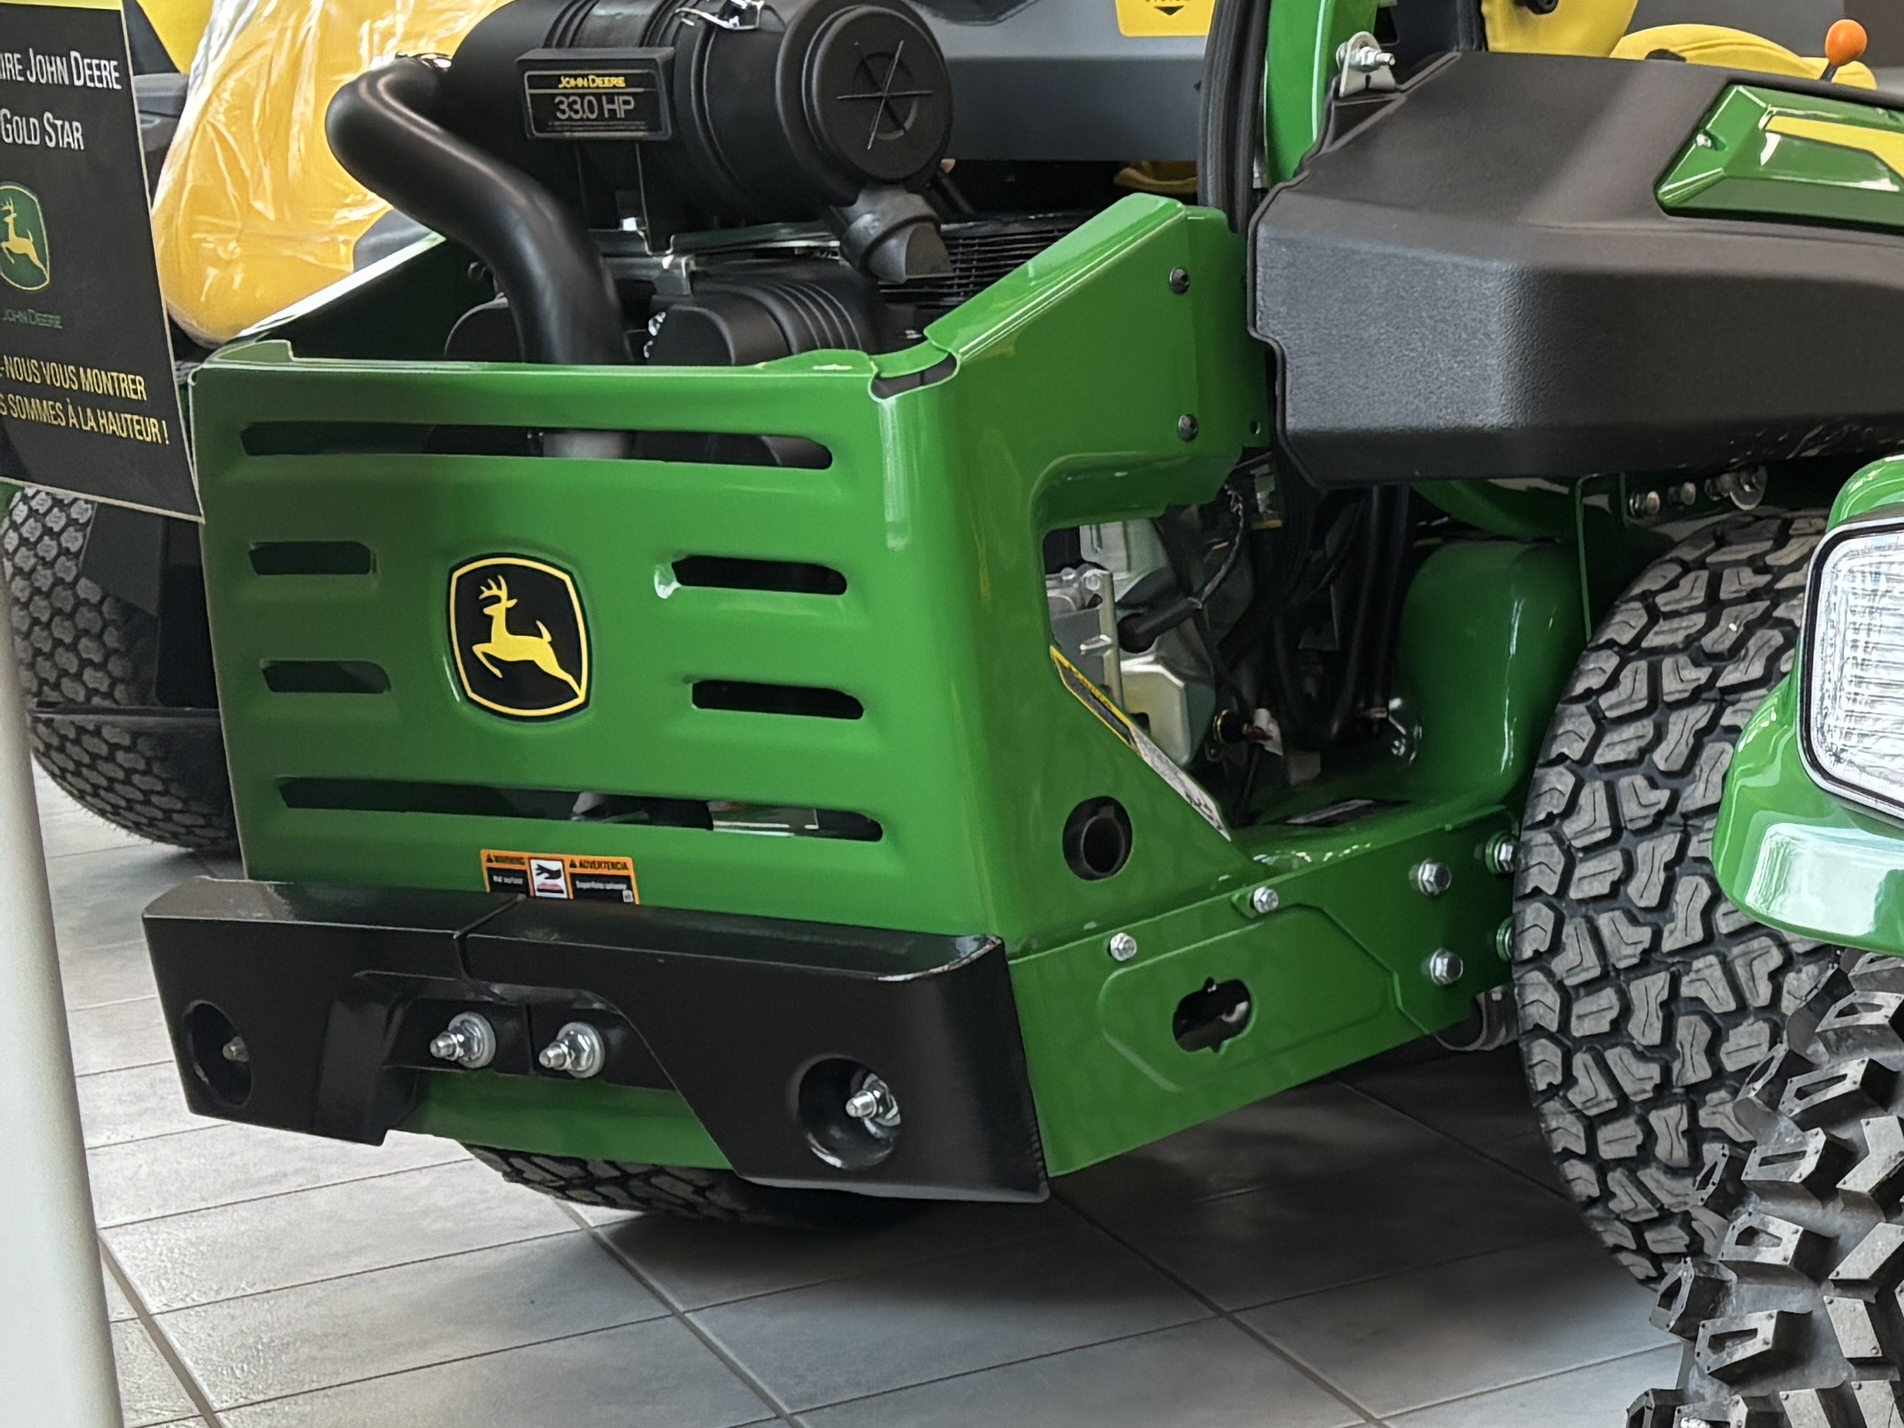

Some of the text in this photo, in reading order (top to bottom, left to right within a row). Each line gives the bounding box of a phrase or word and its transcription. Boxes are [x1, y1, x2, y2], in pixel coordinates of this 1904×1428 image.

[26, 47, 70, 86] JOHN
[70, 50, 122, 90] DEERE
[558, 74, 626, 88] JOHN DEERE
[554, 95, 635, 120] 33.0 HP
[0, 108, 84, 150] GOLD STAR
[2, 308, 63, 329] JOHN DEERE
[0, 354, 147, 401] -NOUS VOUS MONTRER
[7, 393, 66, 427] SOMMES
[66, 397, 80, 430] À
[78, 405, 98, 432] LA
[97, 410, 162, 444] HAUTEUR
